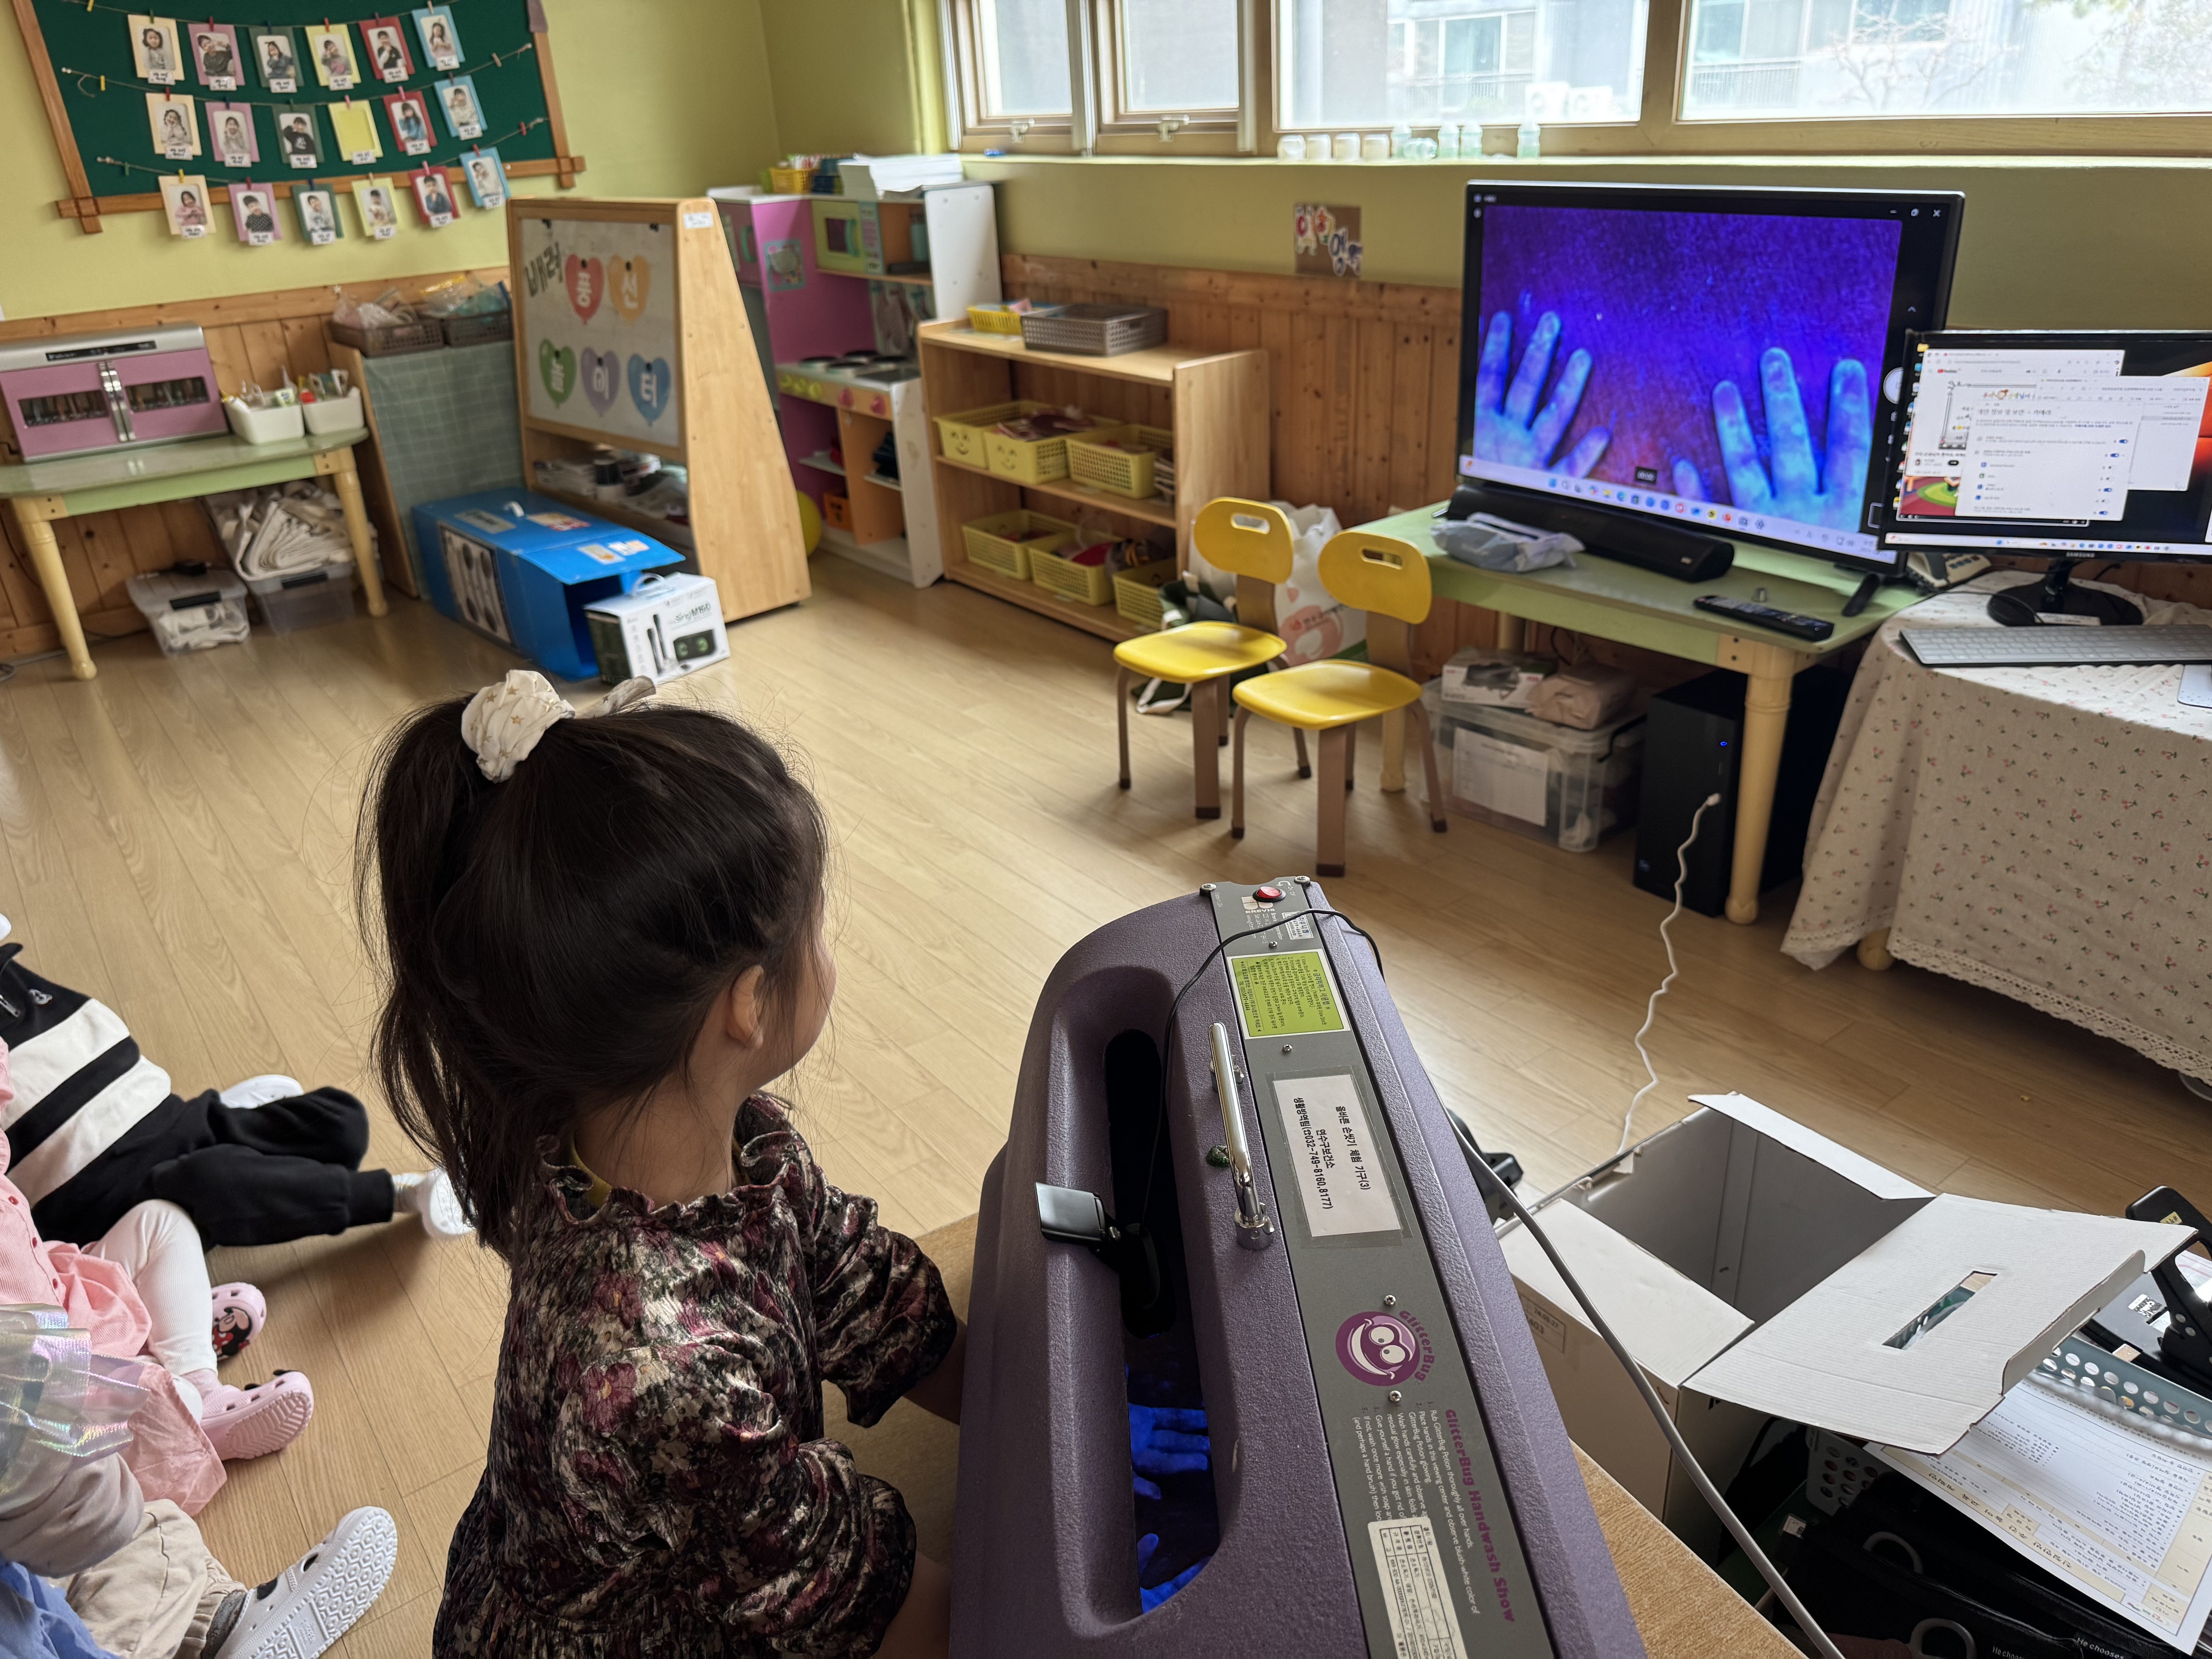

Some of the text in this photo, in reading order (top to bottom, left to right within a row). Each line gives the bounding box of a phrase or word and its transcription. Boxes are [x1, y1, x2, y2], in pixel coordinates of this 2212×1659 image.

[1316, 1129, 1334, 1168] 연수구보건소
[1336, 1106, 1370, 1190] 올바른 손씻기 체험 기구(3)
[1352, 1417, 1362, 1429] (and
[1388, 1414, 1398, 1434] residual
[1355, 1431, 1366, 1453] perhaps
[1368, 1432, 1376, 1446] wash
[1391, 1436, 1400, 1449] glow
[1408, 1412, 1420, 1439] GlitterBug
[1416, 1441, 1425, 1459] Potion
[1423, 1426, 1432, 1443] hands
[1364, 1459, 1372, 1473] hand
[1377, 1429, 1390, 1451] yourself
[1386, 1457, 1395, 1471] hand
[1391, 1490, 1401, 1500] got
[1396, 1451, 1407, 1477] especially
[1397, 1413, 1425, 1509] Wash hands carefully and observe
[1434, 1422, 1445, 1450] GlitterBug
[1442, 1452, 1451, 1470] Potion
[1447, 1472, 1461, 1503] thoroughly
[1432, 1462, 1442, 1484] viewing
[1928, 1473, 1954, 1491] 계획안
[1367, 1474, 1377, 1494] brush)
[1439, 1485, 1448, 1504] center
[1962, 1493, 1979, 1506] 교육
[1408, 1498, 1417, 1513] folds
[1444, 1506, 1453, 1517] and
[1445, 1409, 1515, 1622] GlitterBug Handwash Show
[1984, 1509, 2002, 1522] 놀이
[1448, 1519, 1458, 1544] observe
[2009, 1525, 2027, 1539] 주간
[2033, 1541, 2071, 1568] 친절한반
[1466, 1586, 1475, 1604] color
